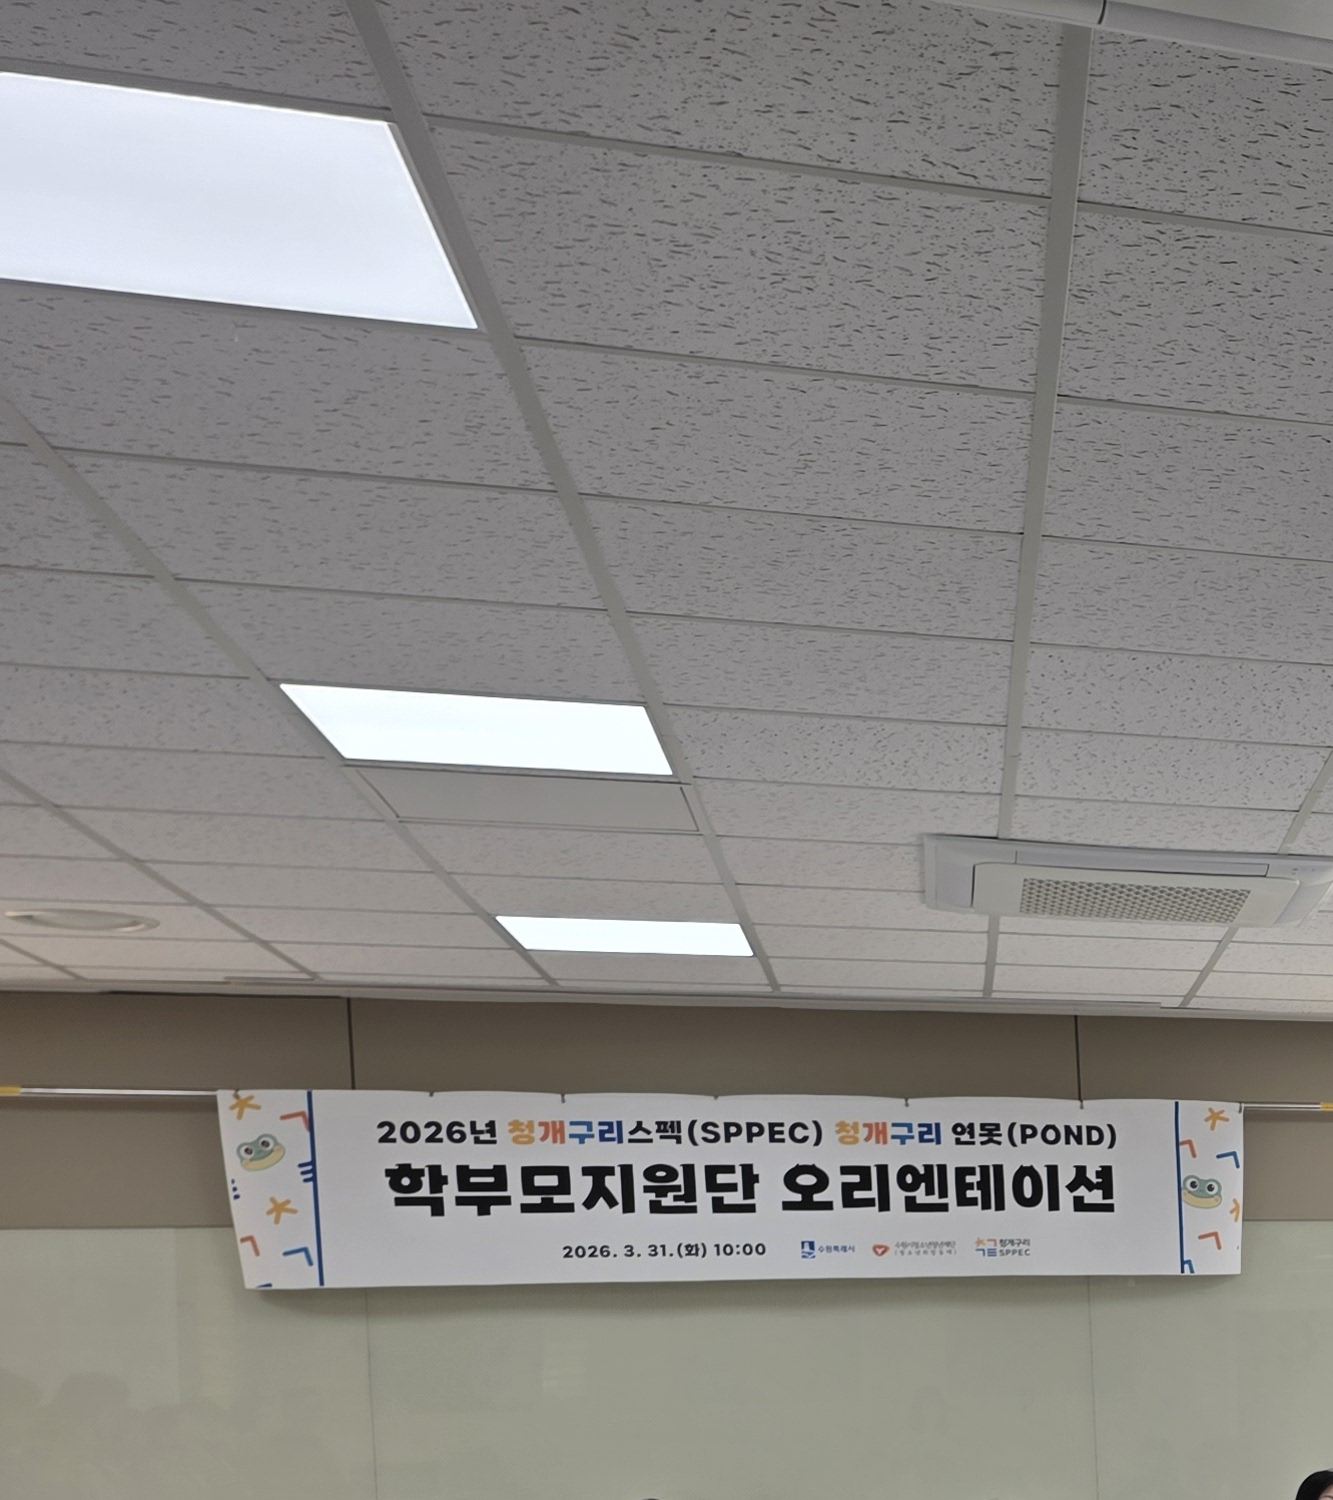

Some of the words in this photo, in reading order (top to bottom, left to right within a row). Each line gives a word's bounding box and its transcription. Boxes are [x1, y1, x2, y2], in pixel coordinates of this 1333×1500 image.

[377, 1120, 497, 1145] 2026년
[507, 1119, 823, 1147] 청개구리스펙(SPPEC)
[835, 1120, 942, 1146] 청개구리
[951, 1122, 1117, 1149] 연못(POND)
[385, 1163, 760, 1217] 학부모지원단
[782, 1163, 1115, 1213] 오리엔테이션
[562, 1245, 618, 1259] 2026.
[623, 1244, 642, 1258] 3.
[647, 1242, 708, 1258] 31.(화)
[713, 1243, 767, 1257] 10:00
[999, 1249, 1031, 1257] SPPEC
